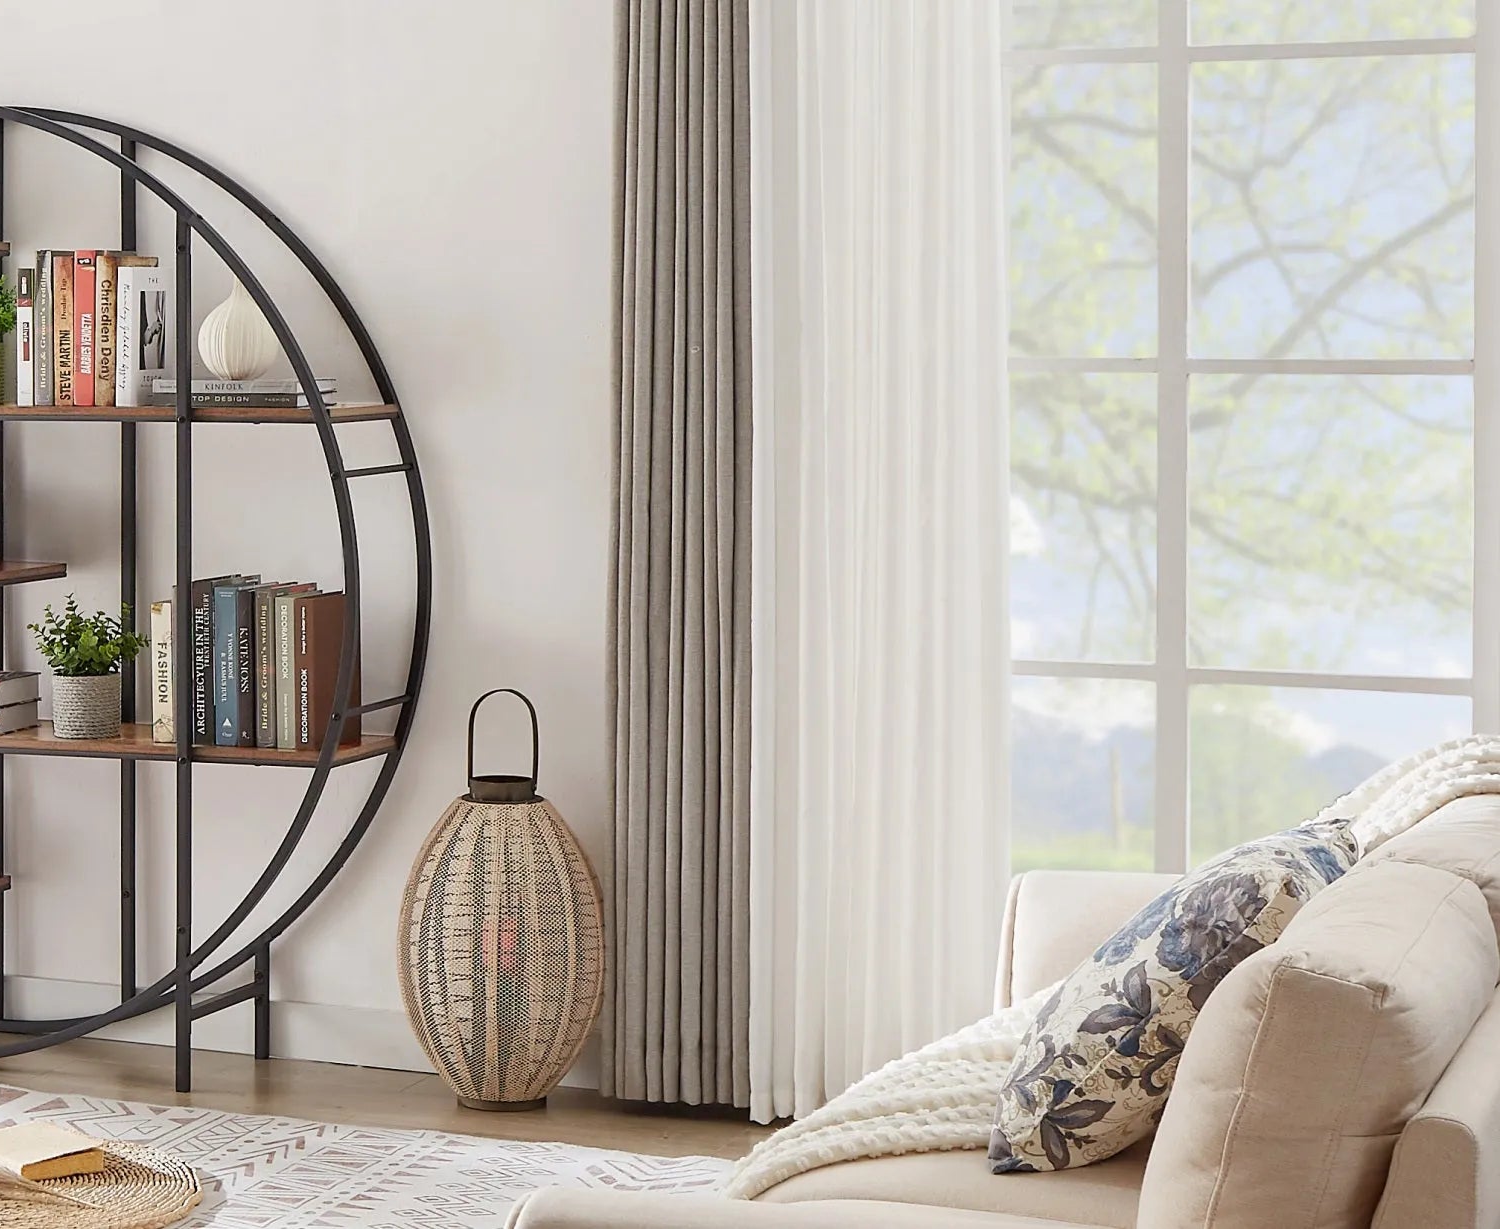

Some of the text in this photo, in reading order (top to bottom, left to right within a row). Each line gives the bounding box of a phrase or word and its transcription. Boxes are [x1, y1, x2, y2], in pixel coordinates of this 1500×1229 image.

[81, 313, 92, 374] BARBIES VENDETTA
[99, 280, 112, 381] Chrisdien Deny
[40, 352, 46, 360] &
[60, 330, 71, 400] STEVE MARTINI
[195, 608, 203, 631] THE
[196, 633, 204, 646] IN
[158, 642, 168, 703] FASHION
[260, 646, 268, 688] Groom's
[262, 691, 268, 700] &
